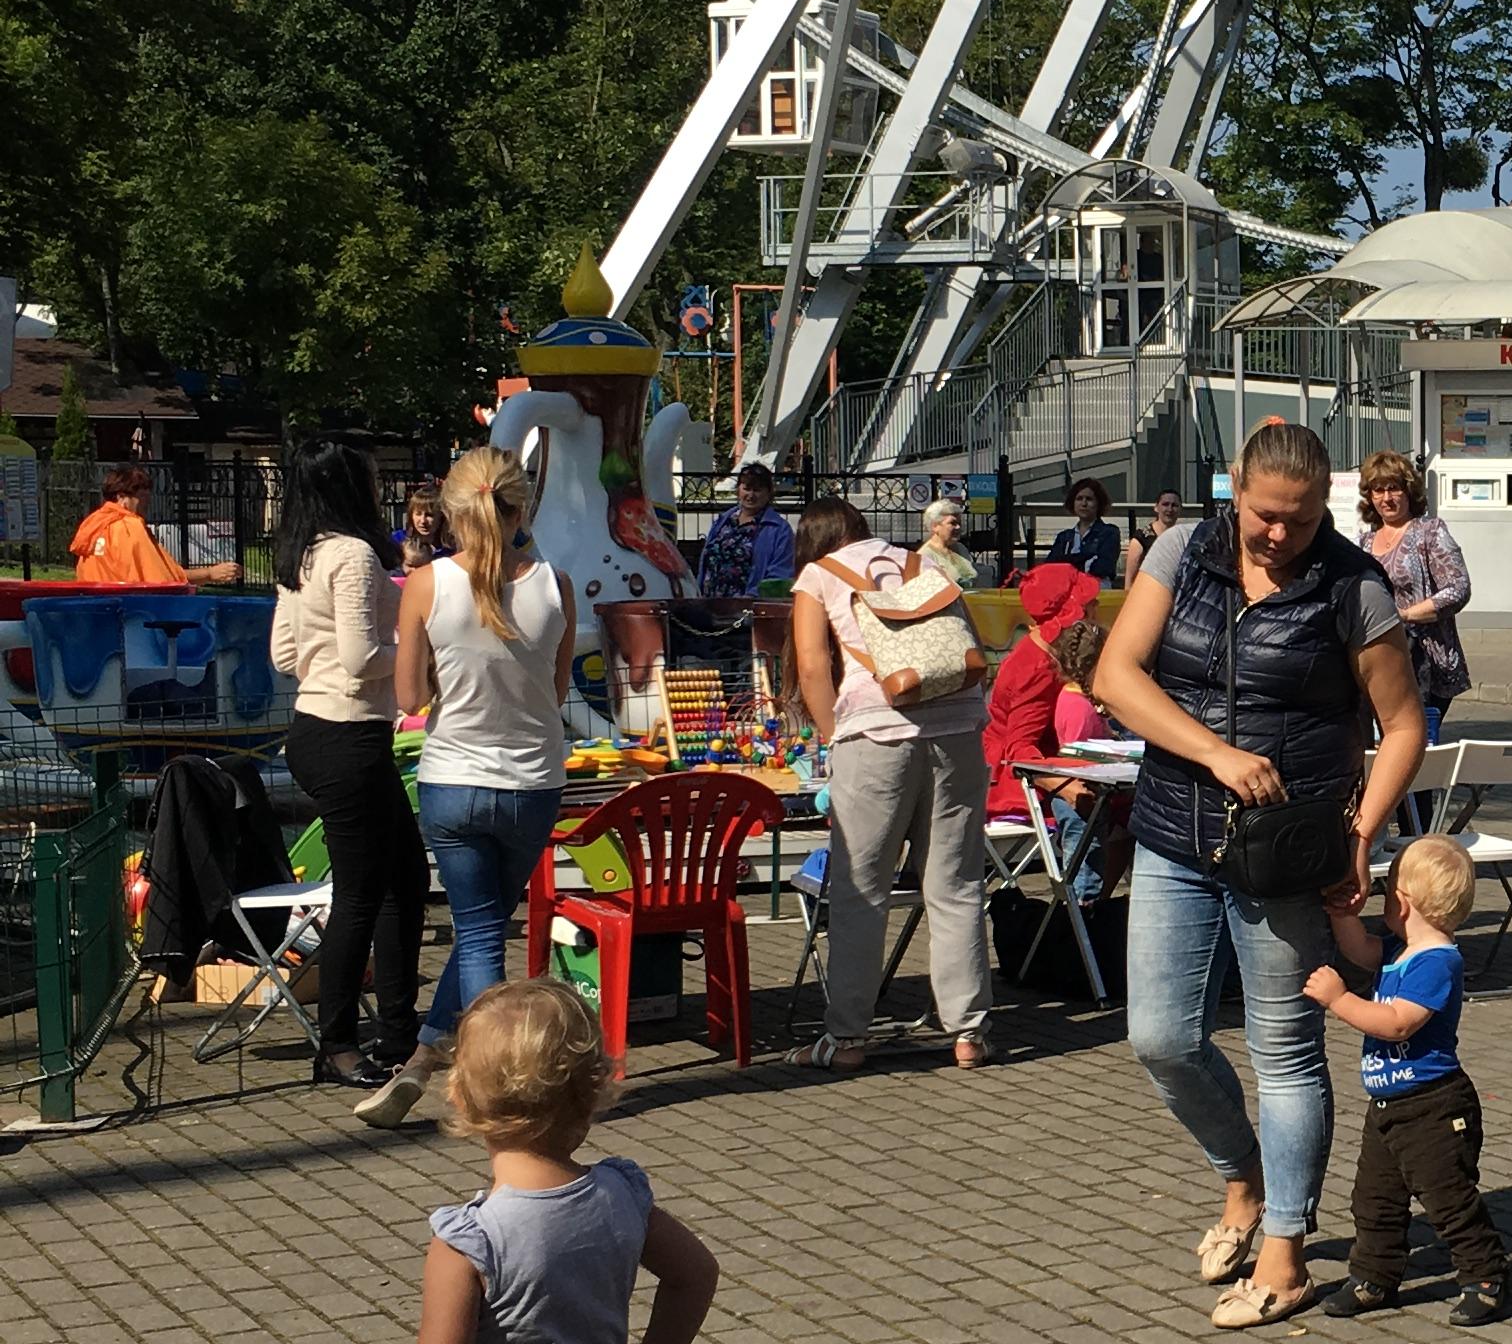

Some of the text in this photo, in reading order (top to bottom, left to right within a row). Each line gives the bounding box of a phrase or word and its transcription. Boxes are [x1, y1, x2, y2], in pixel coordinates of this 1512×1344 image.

[1386, 1040, 1410, 1064] UP
[1363, 1066, 1416, 1089] WITH ME
